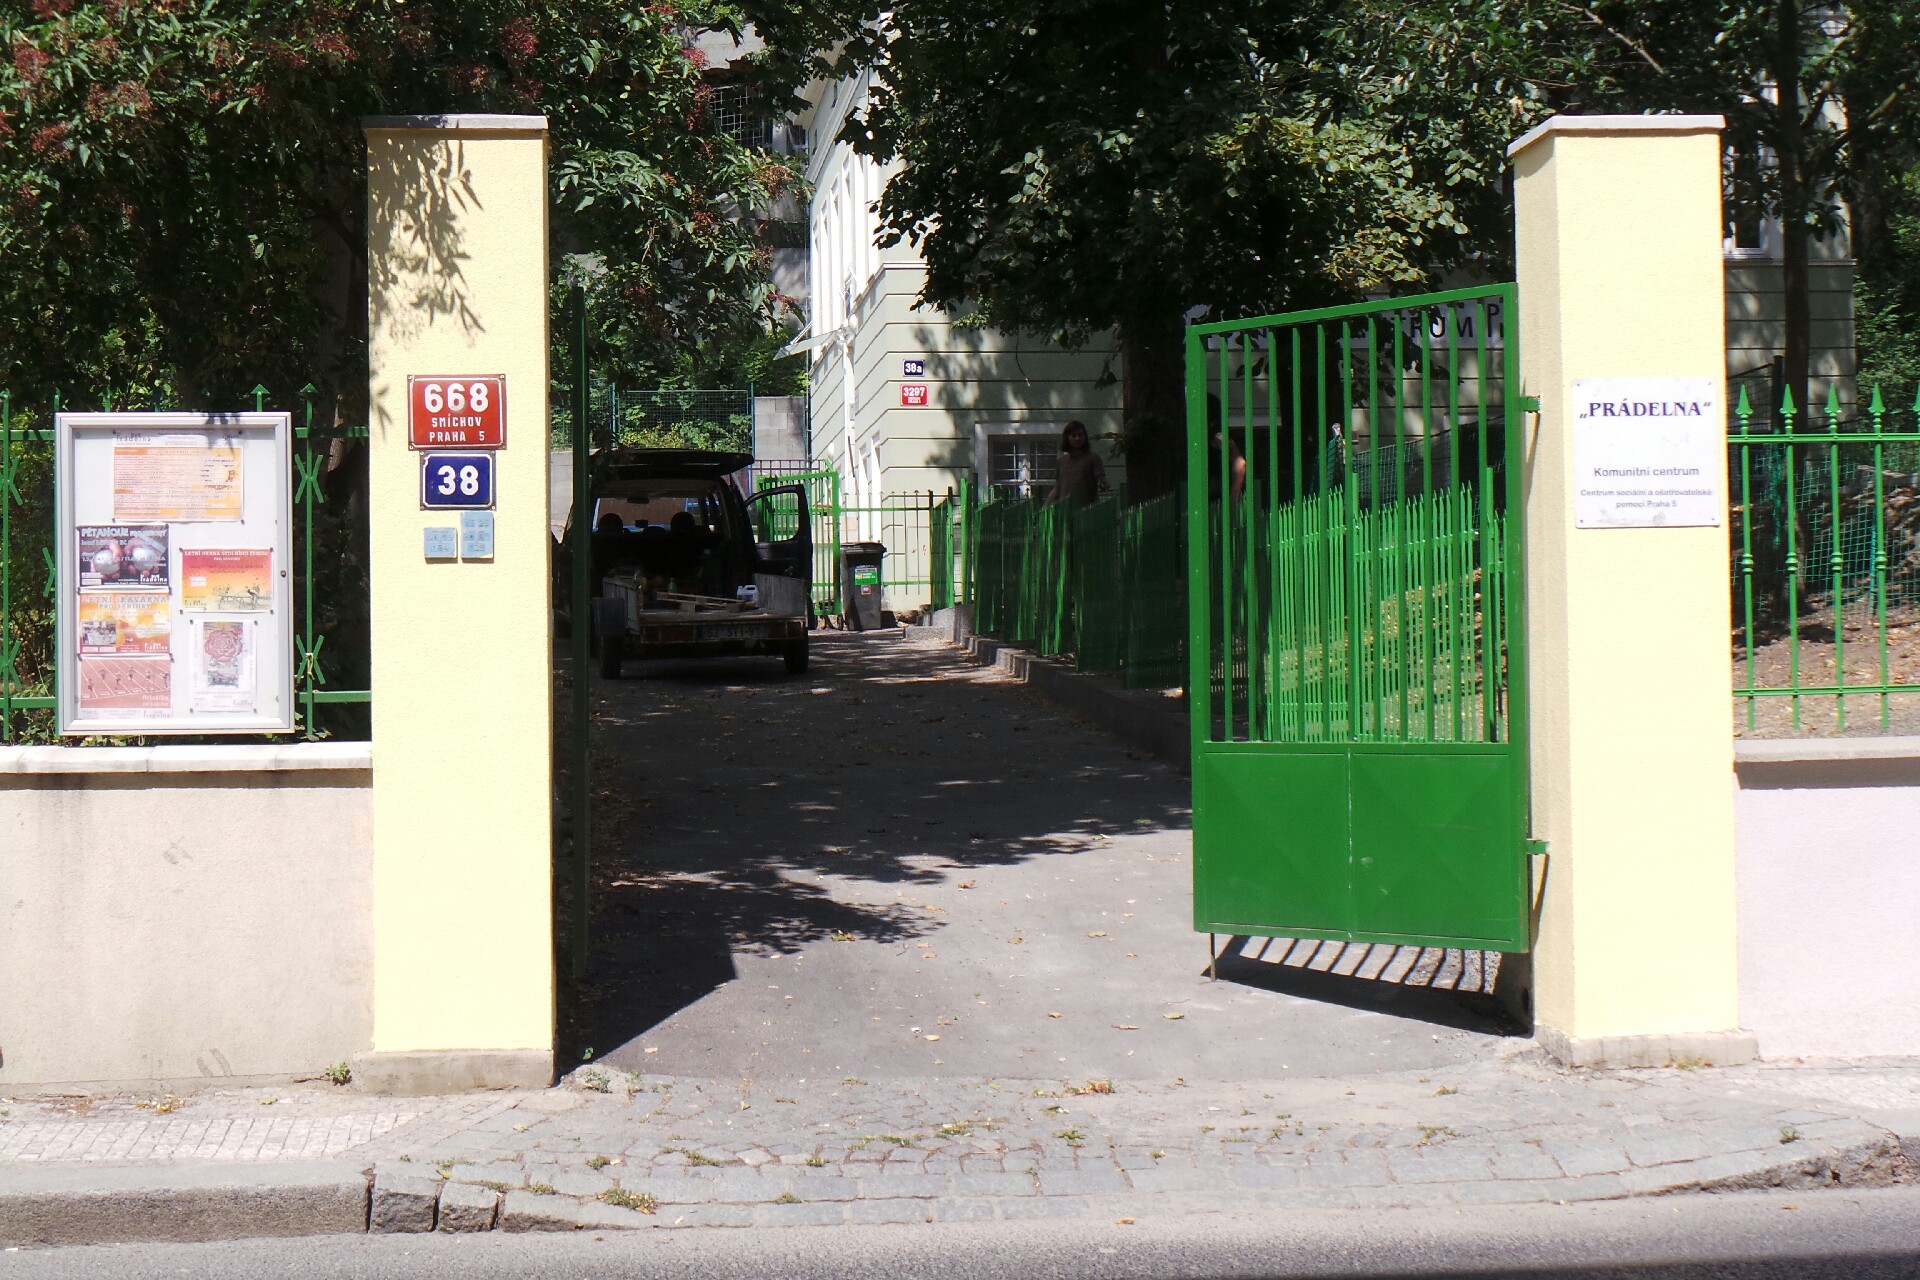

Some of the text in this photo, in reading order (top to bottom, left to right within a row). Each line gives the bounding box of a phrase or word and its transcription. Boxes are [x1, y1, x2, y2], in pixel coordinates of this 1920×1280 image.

[905, 363, 922, 373] 38a
[424, 383, 489, 413] 668
[431, 413, 482, 428] SMÍCHOV
[429, 430, 485, 442] PRAHA 5
[1652, 467, 1700, 476] centrum
[437, 465, 479, 496] 38
[1580, 489, 1614, 497] Centrum
